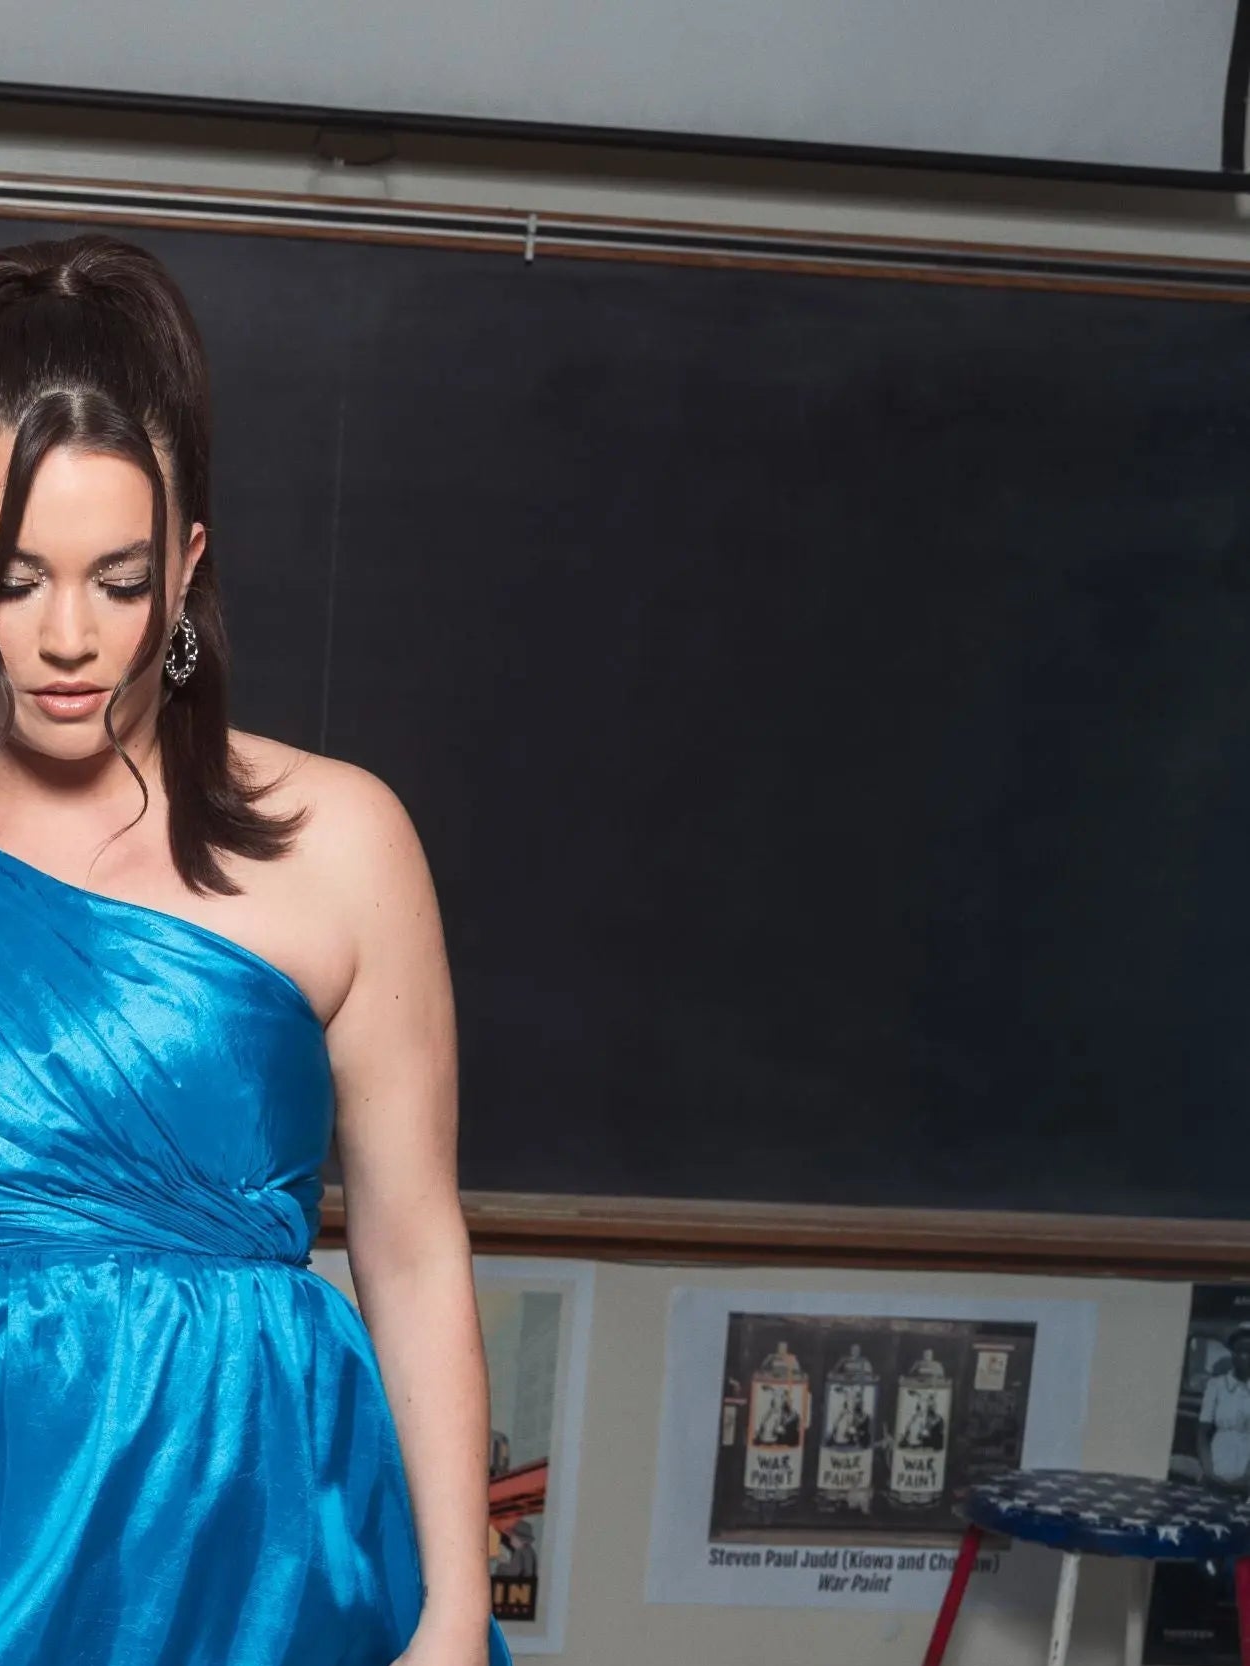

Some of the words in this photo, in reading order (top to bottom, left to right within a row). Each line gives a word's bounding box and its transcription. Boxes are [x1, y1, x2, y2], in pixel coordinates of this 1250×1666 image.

[757, 1456, 790, 1469] WAR
[830, 1456, 861, 1470] WAR
[902, 1456, 935, 1471] WAR
[751, 1470, 794, 1486] PAINT
[823, 1471, 865, 1487] PAINT
[897, 1472, 937, 1488] PAINT
[709, 1547, 761, 1567] Steven
[765, 1549, 798, 1568] Paul
[800, 1550, 839, 1569] Judd
[842, 1551, 893, 1573] (Kiowa
[897, 1552, 925, 1570] and
[929, 1554, 999, 1574] Choaw)
[817, 1573, 848, 1592] War
[851, 1573, 893, 1593] Paint
